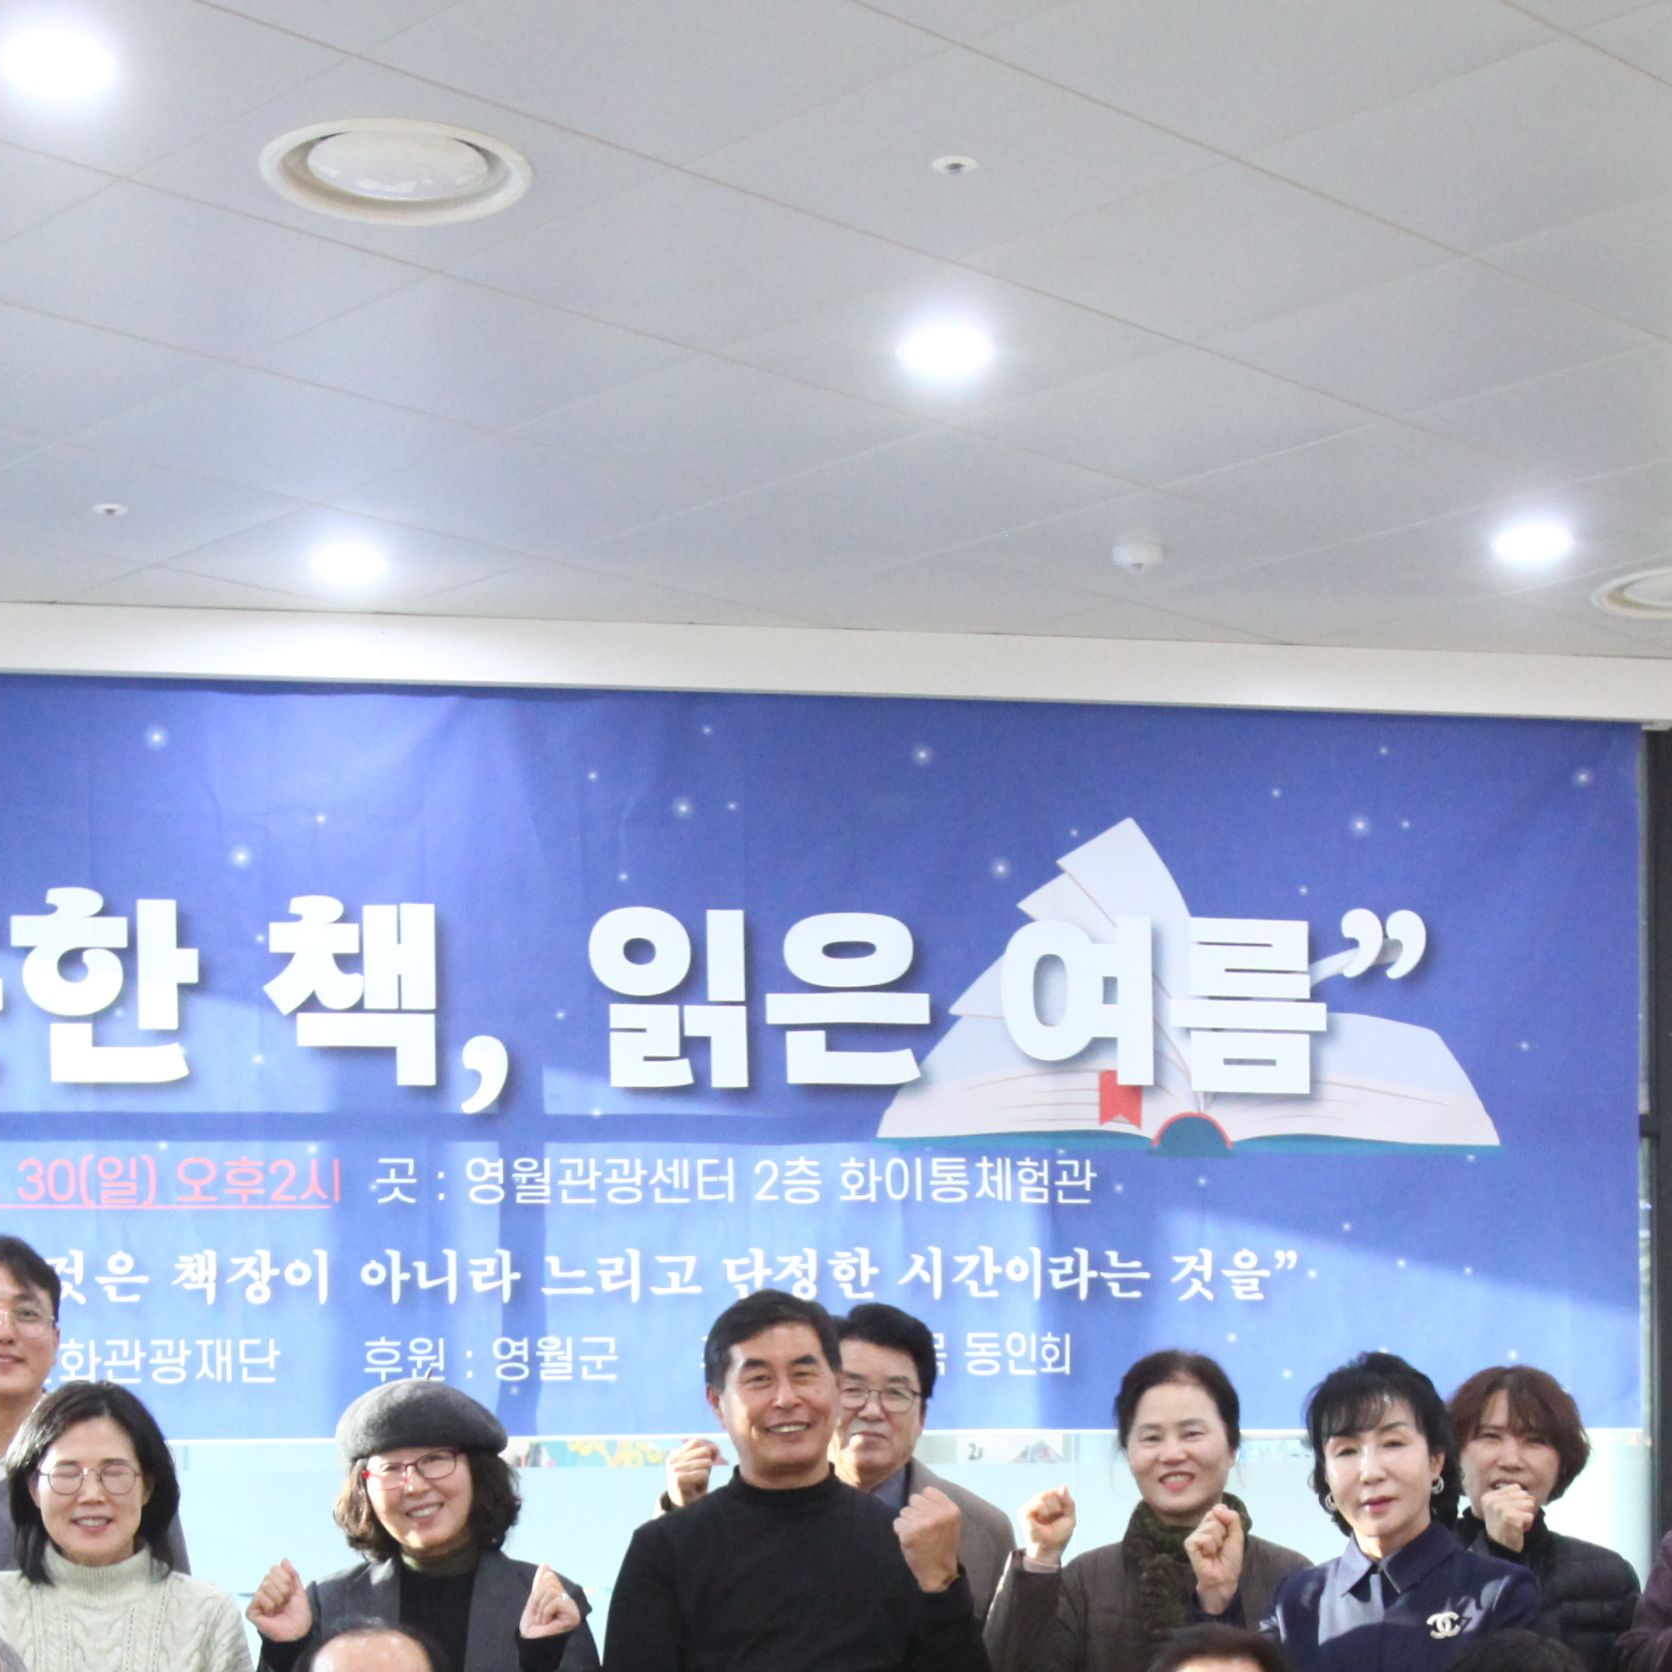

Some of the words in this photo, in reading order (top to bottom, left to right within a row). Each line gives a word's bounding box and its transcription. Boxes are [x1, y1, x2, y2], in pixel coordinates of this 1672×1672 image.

[263, 894, 509, 1114] 책,
[587, 903, 932, 1090] 읽은
[999, 905, 1428, 1097] 여름”
[17, 1154, 157, 1207] 30(일)
[176, 1156, 341, 1206] 오후2시
[375, 1157, 418, 1204] 곳
[464, 1156, 735, 1205] 영월관광센터
[754, 1156, 822, 1205] 2층
[839, 1155, 1098, 1207] 화이통체험관
[171, 1247, 329, 1307] 책장이
[359, 1247, 522, 1305] 아니라
[541, 1246, 703, 1304] 느리고
[721, 1246, 880, 1301] 단정한
[896, 1244, 1152, 1302] 시간이라는
[1170, 1246, 1300, 1303] 것을”
[362, 1336, 446, 1384] 후원
[491, 1335, 620, 1384] 영월군
[964, 1330, 1072, 1378] 동인회
